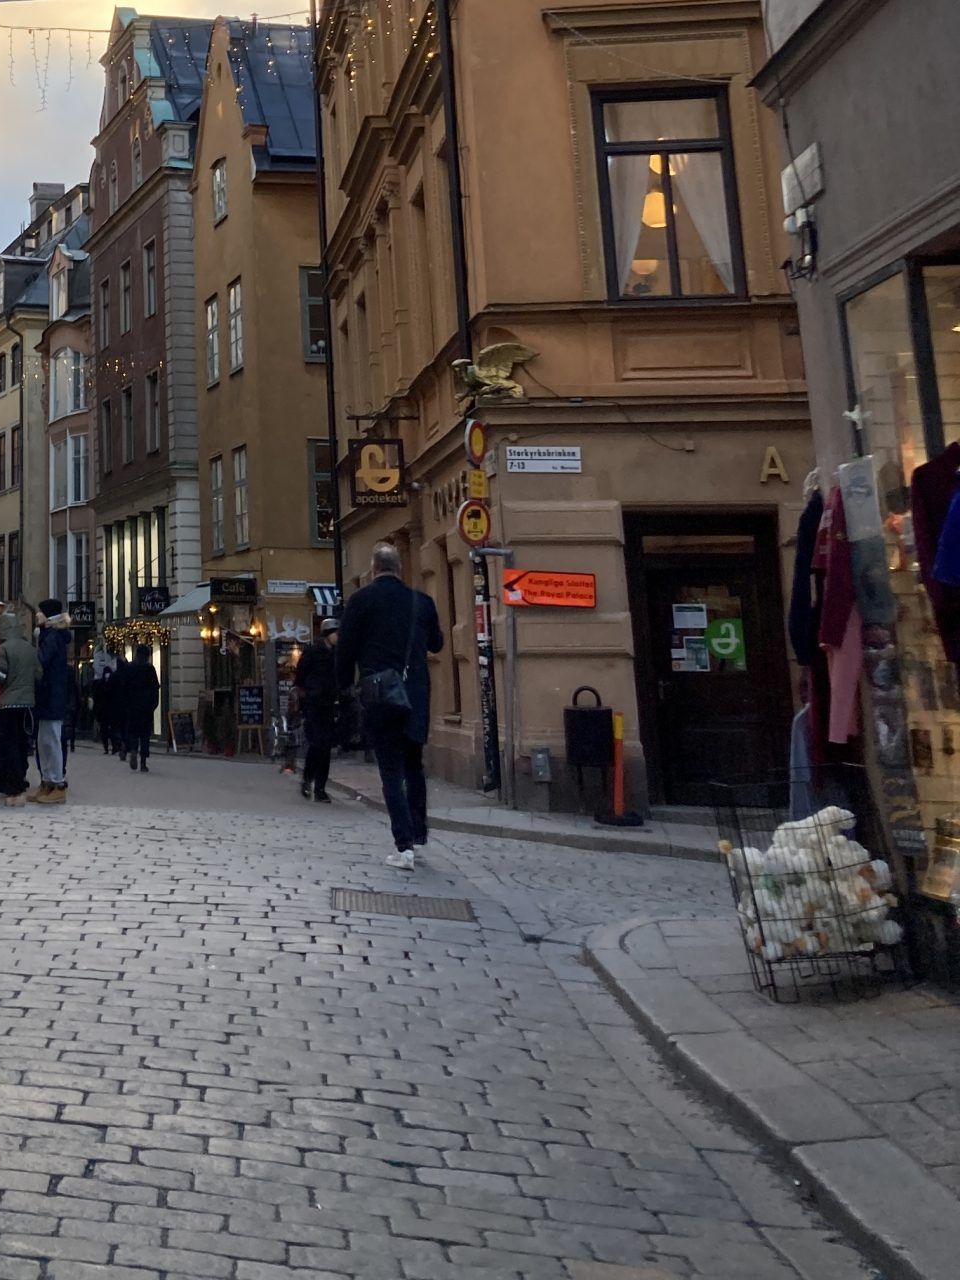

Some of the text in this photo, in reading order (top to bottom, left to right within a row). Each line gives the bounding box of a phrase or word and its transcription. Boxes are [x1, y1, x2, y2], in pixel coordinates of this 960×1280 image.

[508, 449, 576, 459] Storkyrkobrinken
[509, 461, 526, 470] 7-13
[355, 494, 401, 505] apoteket
[527, 578, 564, 588] Kungliga
[523, 589, 594, 600] The Royal Palace
